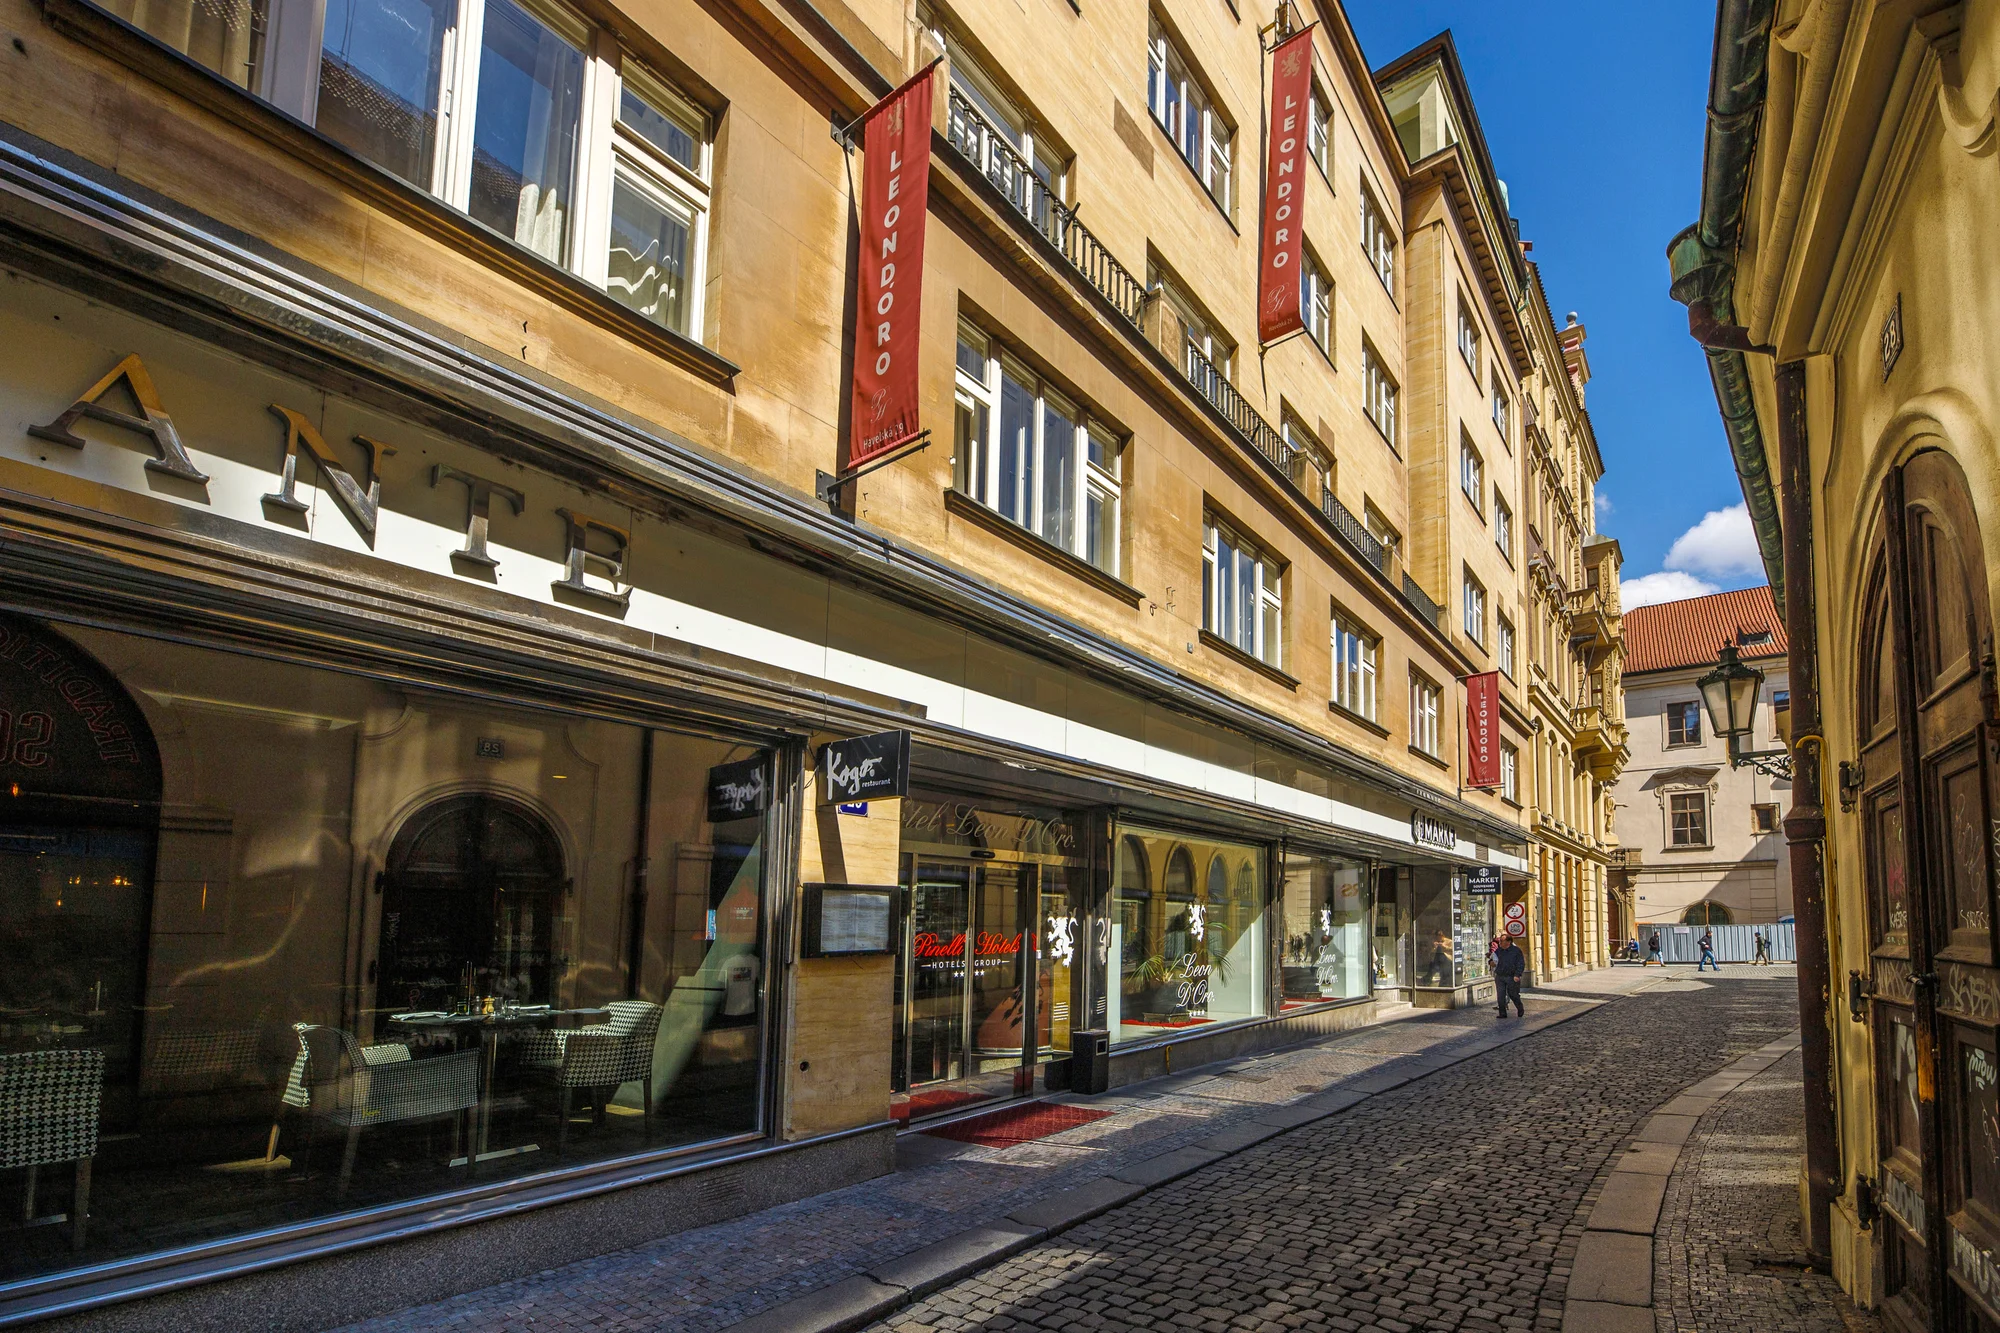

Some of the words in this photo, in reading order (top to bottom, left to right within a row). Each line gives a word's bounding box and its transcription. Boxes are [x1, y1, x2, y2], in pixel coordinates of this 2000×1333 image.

[1884, 319, 1897, 362] 28
[863, 426, 893, 450] Havelská
[894, 422, 904, 438] 29
[861, 777, 892, 789] restaurant
[946, 803, 1009, 842] Leon
[914, 932, 967, 957] Pinelli
[975, 931, 1022, 955] Hotels
[932, 960, 966, 969] HOTELS
[974, 959, 1002, 967] GROUP
[1179, 952, 1212, 979] Leon
